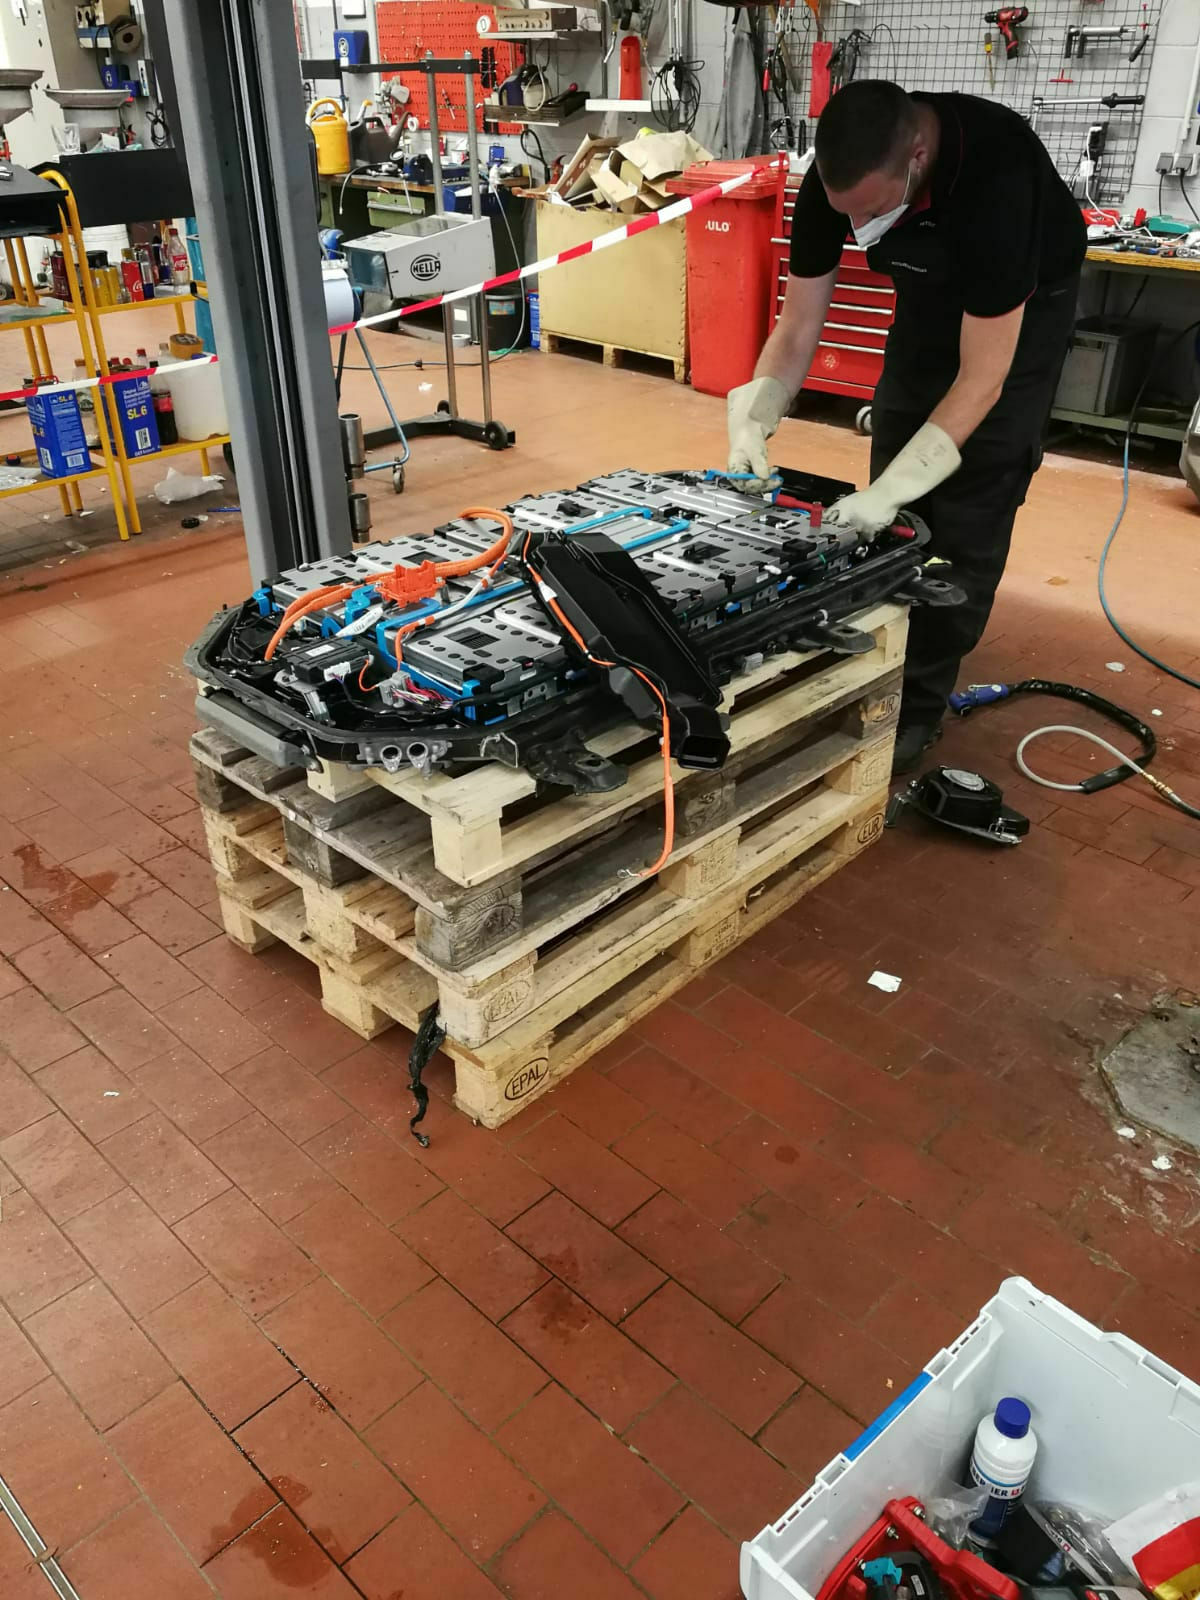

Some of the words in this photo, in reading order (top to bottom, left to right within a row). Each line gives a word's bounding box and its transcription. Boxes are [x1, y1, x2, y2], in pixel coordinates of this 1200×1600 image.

[413, 260, 441, 273] HELLA
[127, 405, 148, 420] SL.6
[863, 816, 880, 841] EUR
[512, 1064, 544, 1097] EPAL
